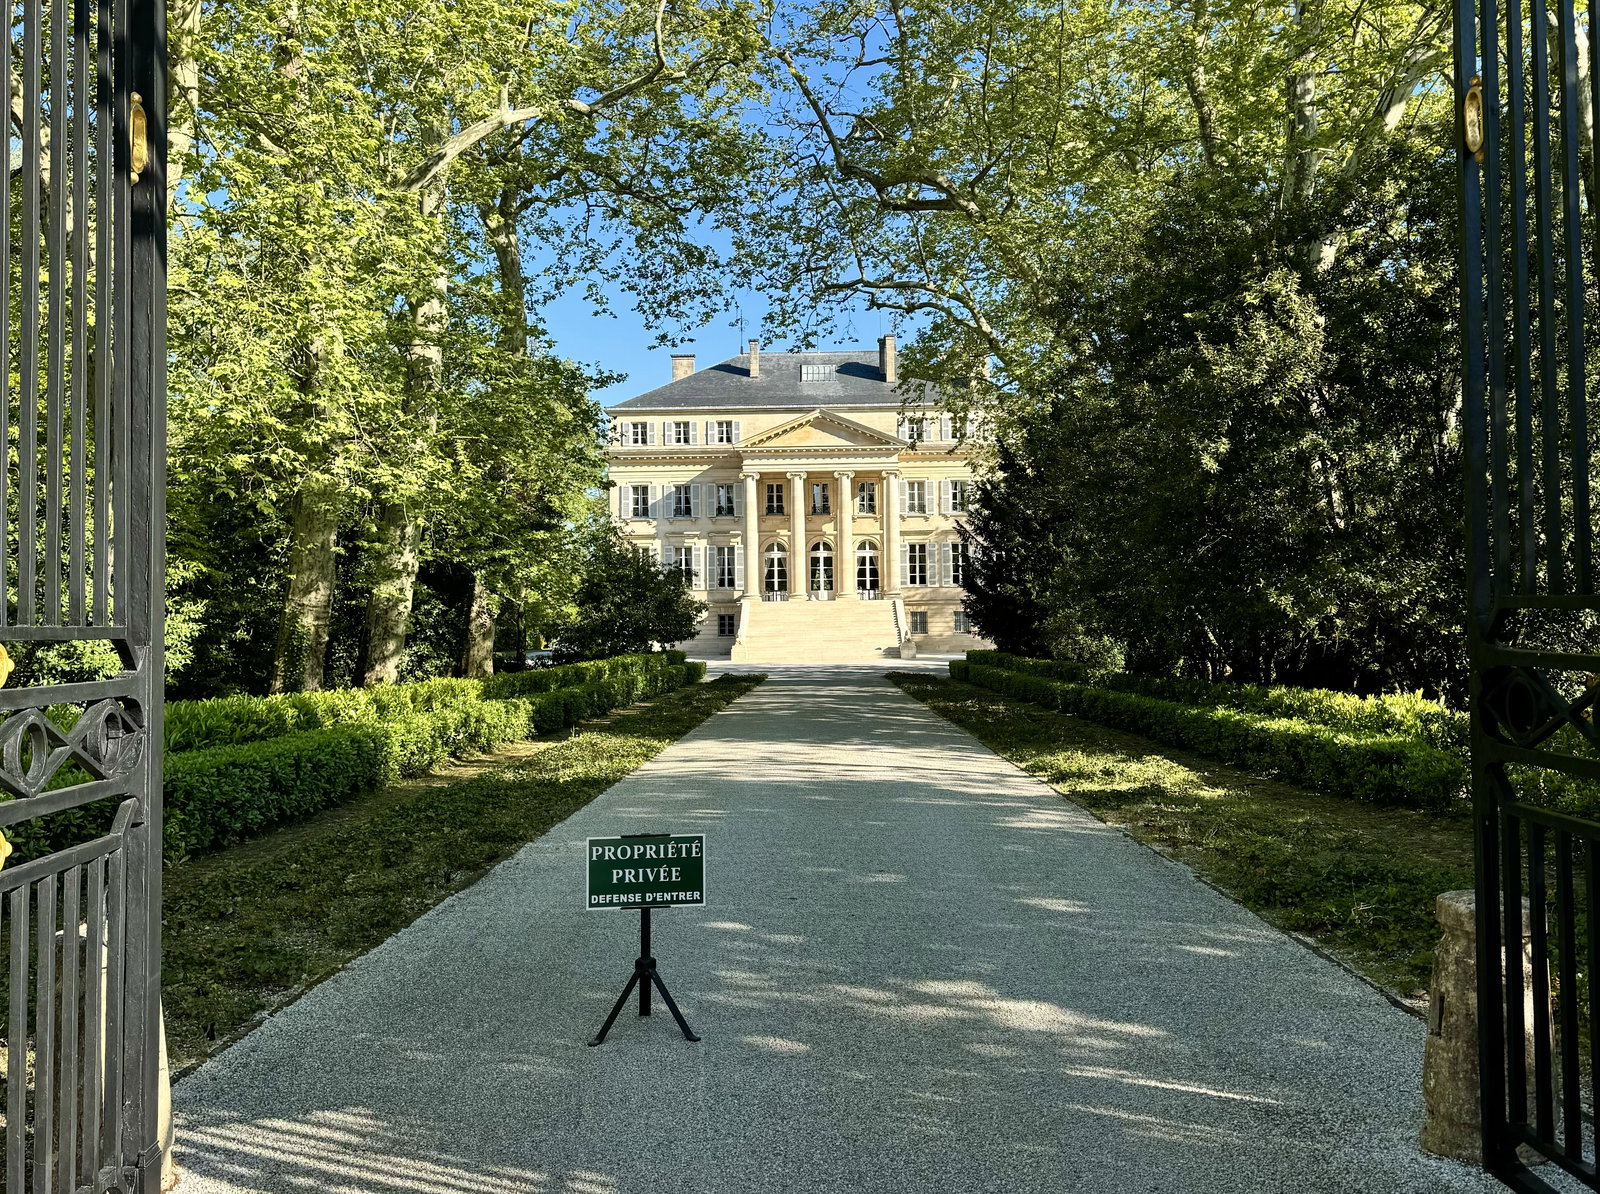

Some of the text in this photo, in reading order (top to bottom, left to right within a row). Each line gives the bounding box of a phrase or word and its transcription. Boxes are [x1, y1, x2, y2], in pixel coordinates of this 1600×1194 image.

[591, 840, 701, 860] PROPRIÉTÉ
[611, 864, 681, 884] PRIVÉE
[591, 891, 701, 904] DEFENSE D'ENTRER
